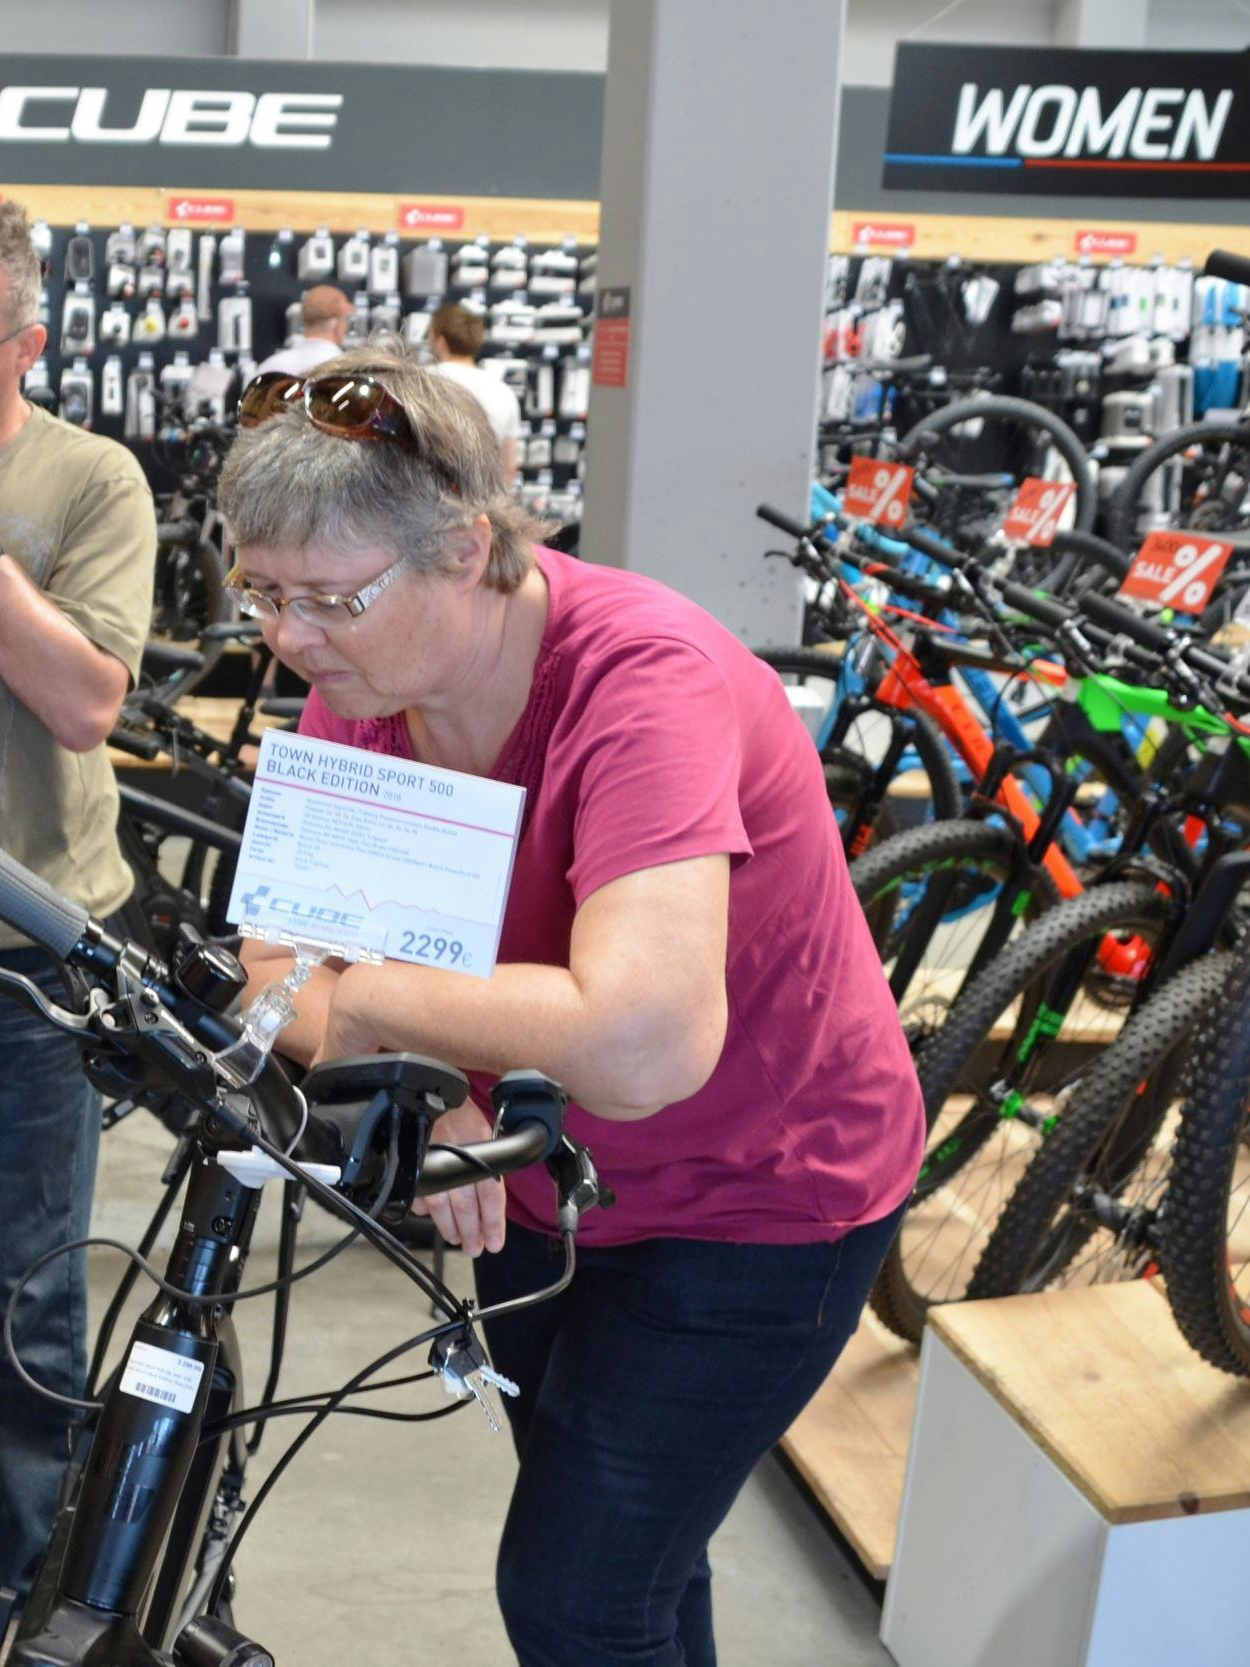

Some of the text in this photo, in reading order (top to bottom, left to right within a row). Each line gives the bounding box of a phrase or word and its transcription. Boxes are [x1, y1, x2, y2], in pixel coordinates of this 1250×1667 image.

[951, 82, 1234, 160] WOMEN
[848, 466, 907, 522] SALE %
[1011, 506, 1039, 525] SALE
[1025, 485, 1069, 541] %
[1133, 543, 1223, 607] SALE %
[266, 759, 317, 782] BLACK
[321, 771, 380, 797] EDITION
[270, 743, 454, 797] TOWN HYBRID SPORT 500
[268, 898, 365, 930] CUBE
